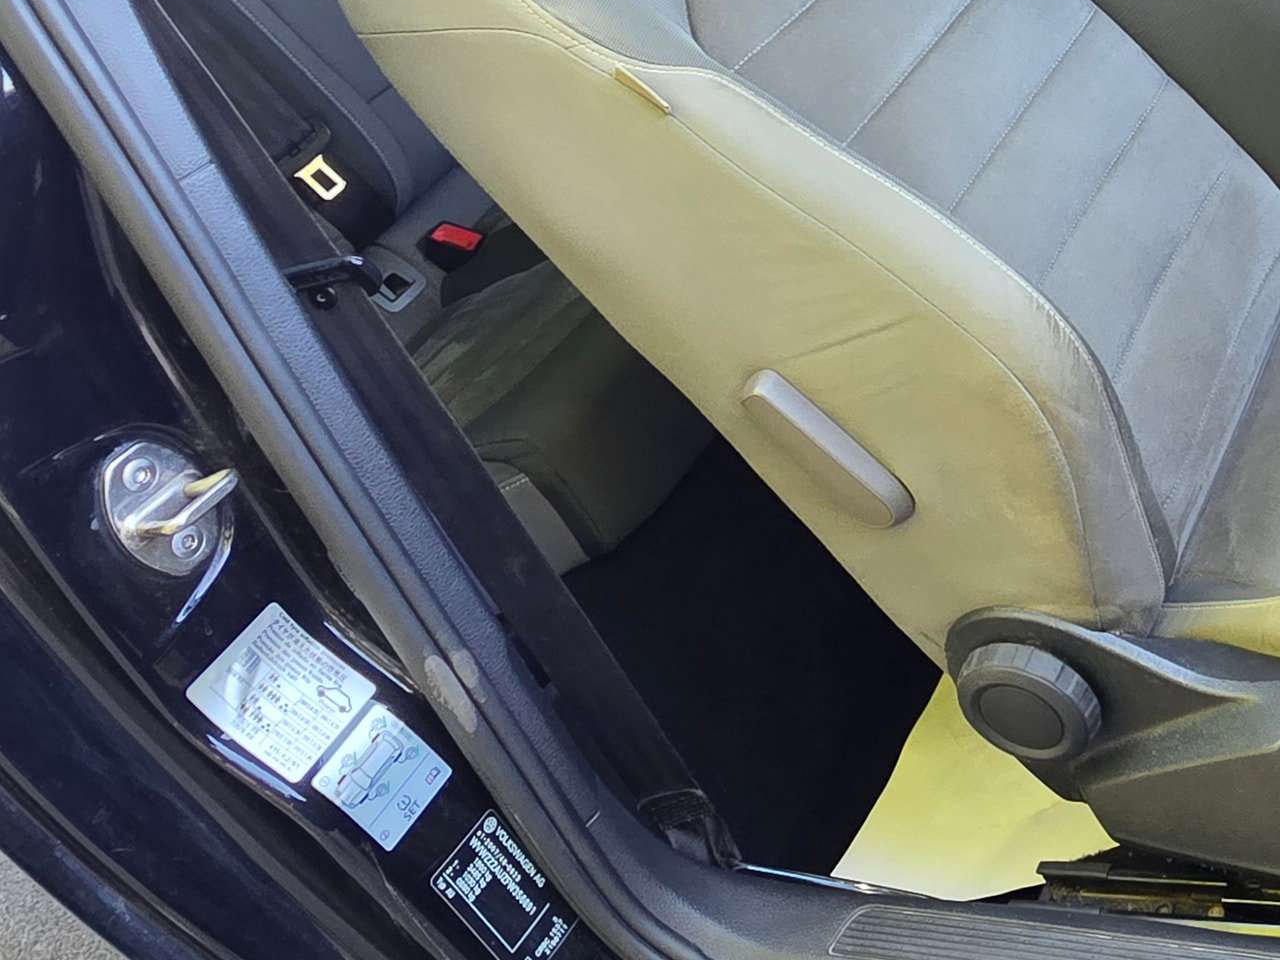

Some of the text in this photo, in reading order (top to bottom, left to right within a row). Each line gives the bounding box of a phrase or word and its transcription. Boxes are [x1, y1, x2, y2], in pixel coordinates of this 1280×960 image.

[403, 800, 420, 822] SET
[496, 826, 546, 888] VOLKSWAGEN AG
